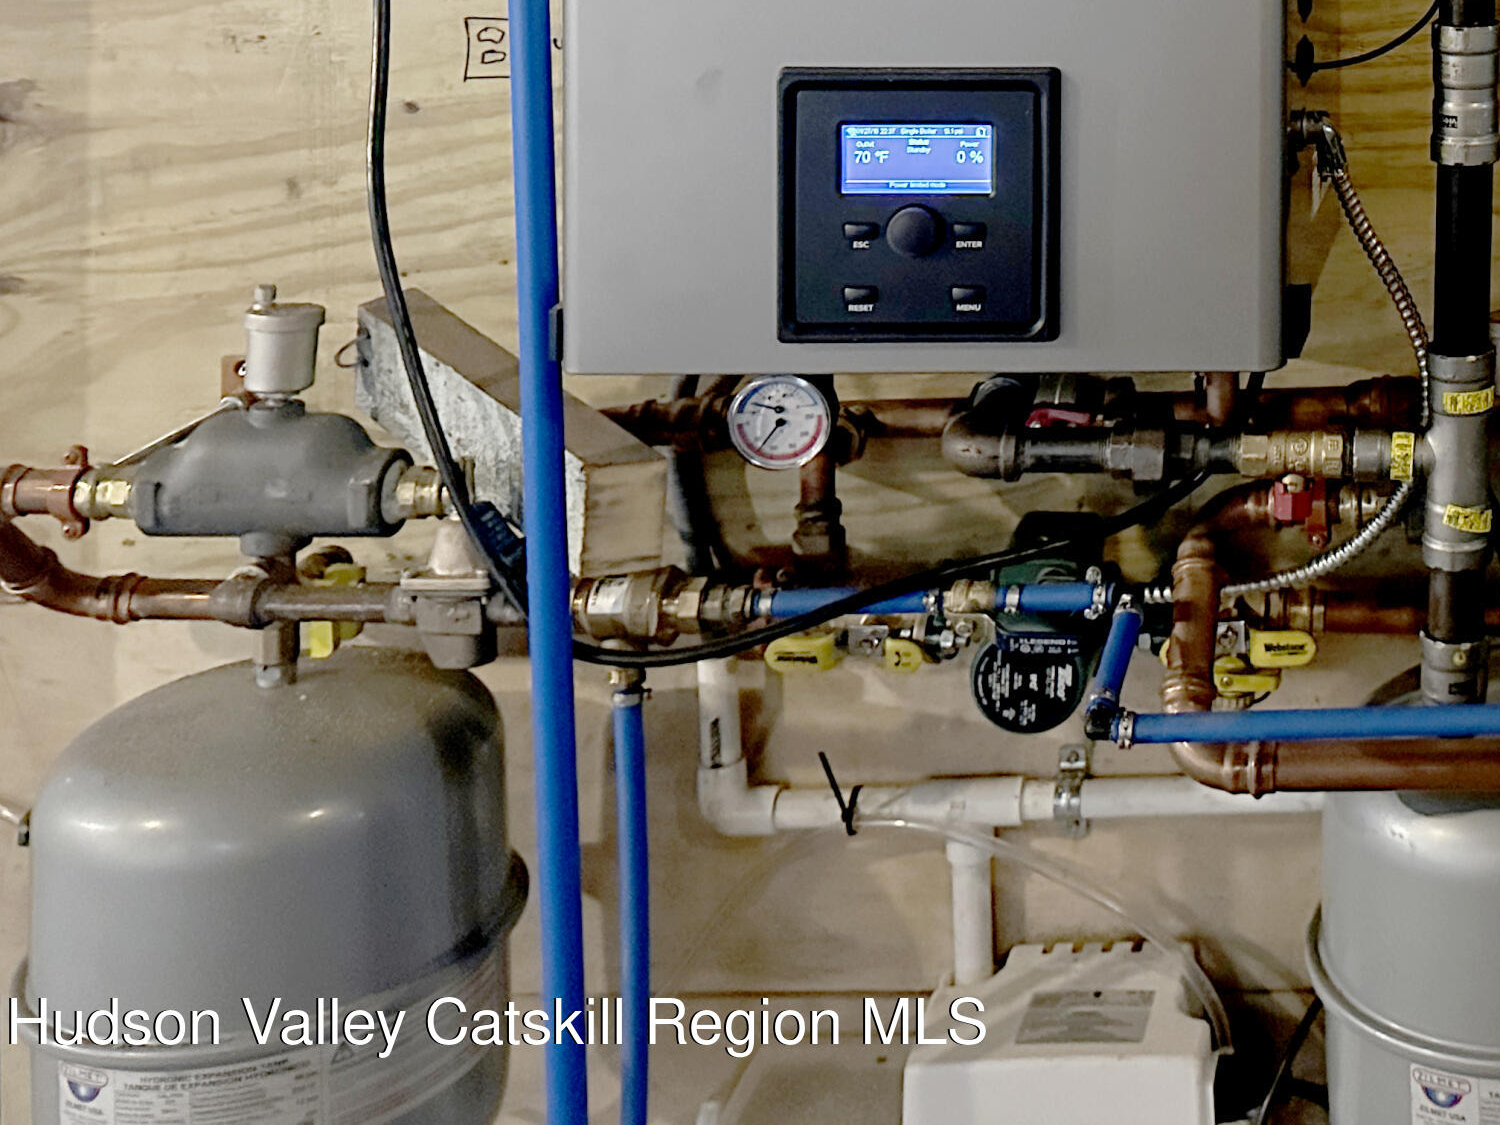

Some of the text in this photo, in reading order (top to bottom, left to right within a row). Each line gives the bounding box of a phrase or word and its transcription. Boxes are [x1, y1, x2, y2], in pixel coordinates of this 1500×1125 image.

[854, 151, 870, 163] 70
[956, 151, 984, 163] 0 %
[853, 241, 870, 249] ESC
[956, 241, 982, 249] ENTER
[848, 304, 874, 313] RESET
[956, 304, 982, 312] MENU
